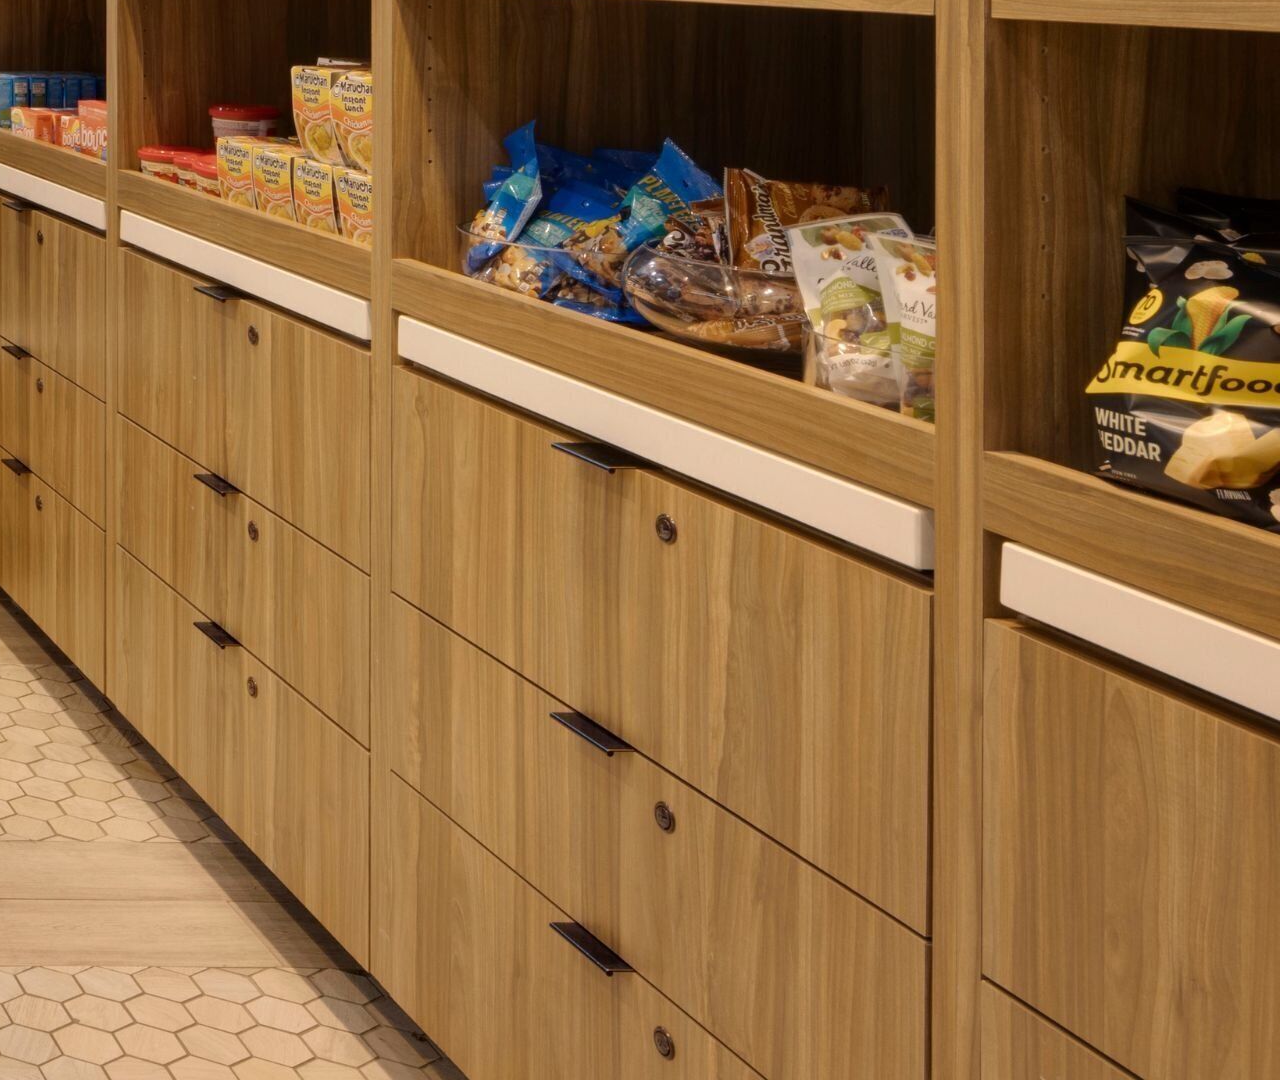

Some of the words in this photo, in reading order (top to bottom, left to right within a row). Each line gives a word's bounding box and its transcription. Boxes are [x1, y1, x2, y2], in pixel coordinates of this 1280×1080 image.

[300, 72, 328, 88] Maruchan
[341, 94, 366, 105] Instant
[344, 104, 364, 113] Lunch
[260, 154, 288, 171] Maruchan
[262, 167, 281, 179] Instant
[301, 164, 329, 181] Maruchan
[264, 176, 280, 186] Lunch
[303, 178, 322, 190] Instant
[305, 188, 321, 198] Lunch
[347, 190, 370, 204] Instant
[351, 200, 369, 212] Lunch
[1095, 406, 1146, 437] WHITE
